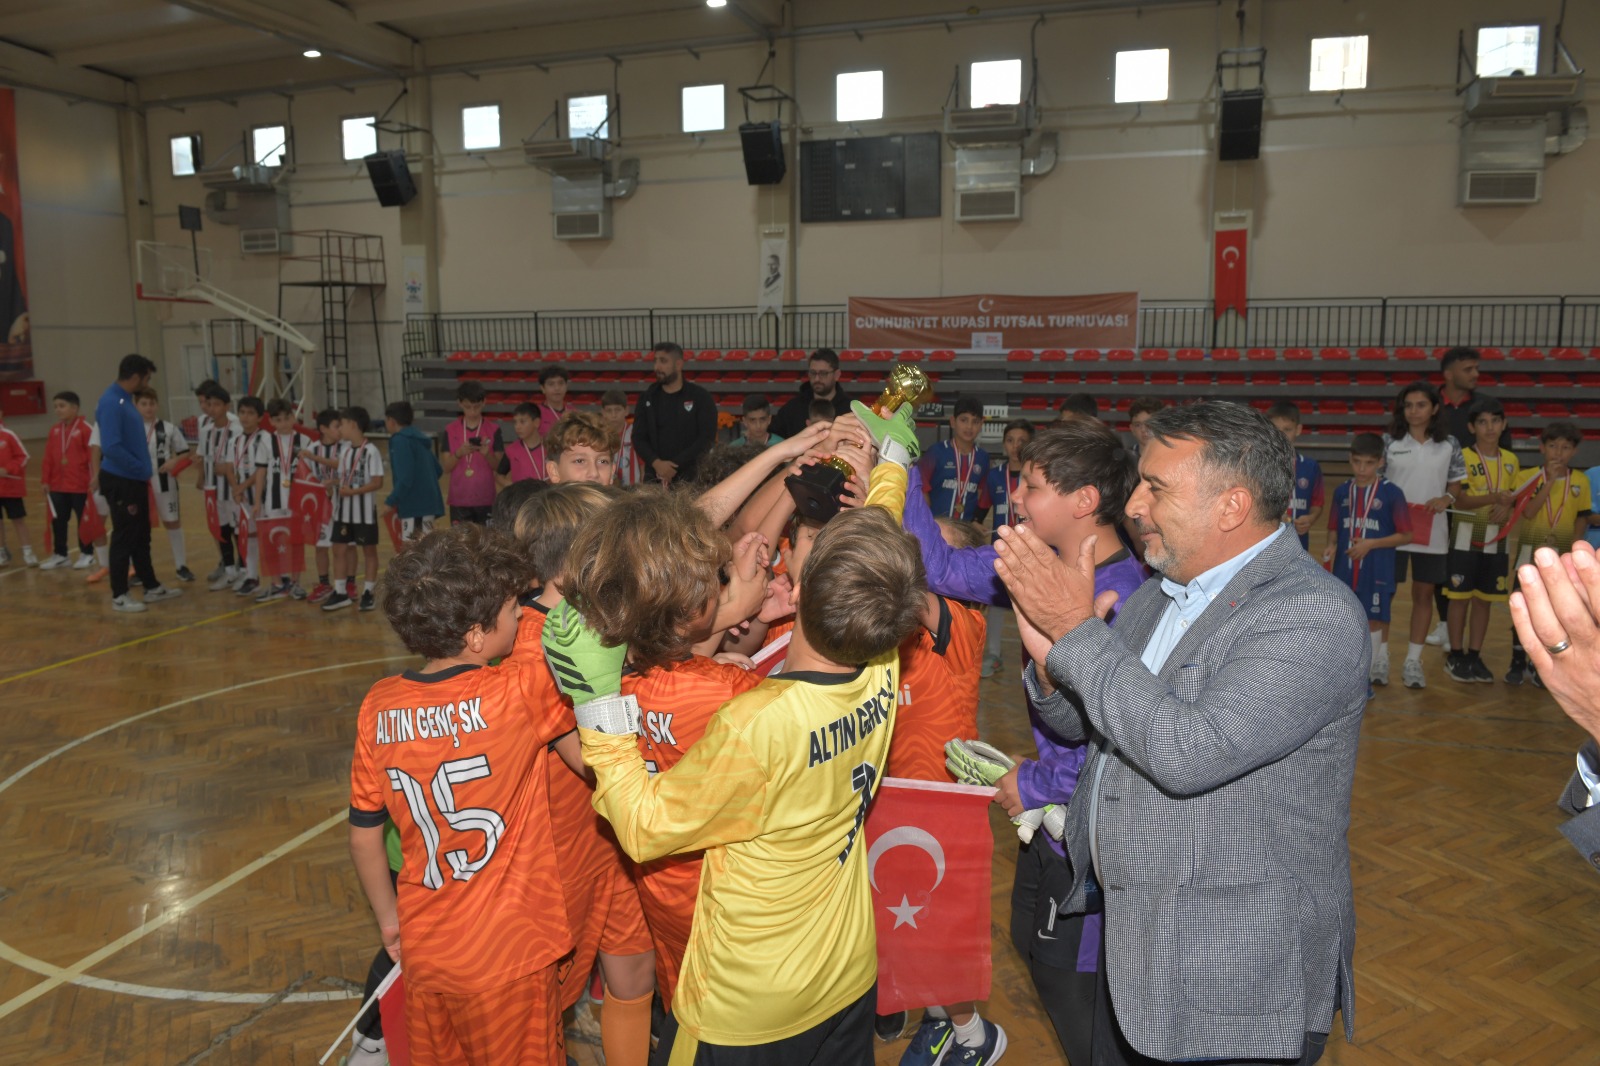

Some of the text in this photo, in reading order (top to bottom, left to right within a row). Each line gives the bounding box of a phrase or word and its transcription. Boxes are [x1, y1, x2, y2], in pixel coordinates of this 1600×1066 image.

[942, 315, 990, 328] KUPASI
[993, 314, 1045, 328] FUTSAL
[1047, 314, 1129, 328] TURNUVASI
[1372, 592, 1380, 606] 6
[376, 697, 489, 748] ALTIN GENÇ SK
[646, 710, 677, 746] SK
[808, 713, 856, 768] ALTIN
[385, 753, 506, 890] 15
